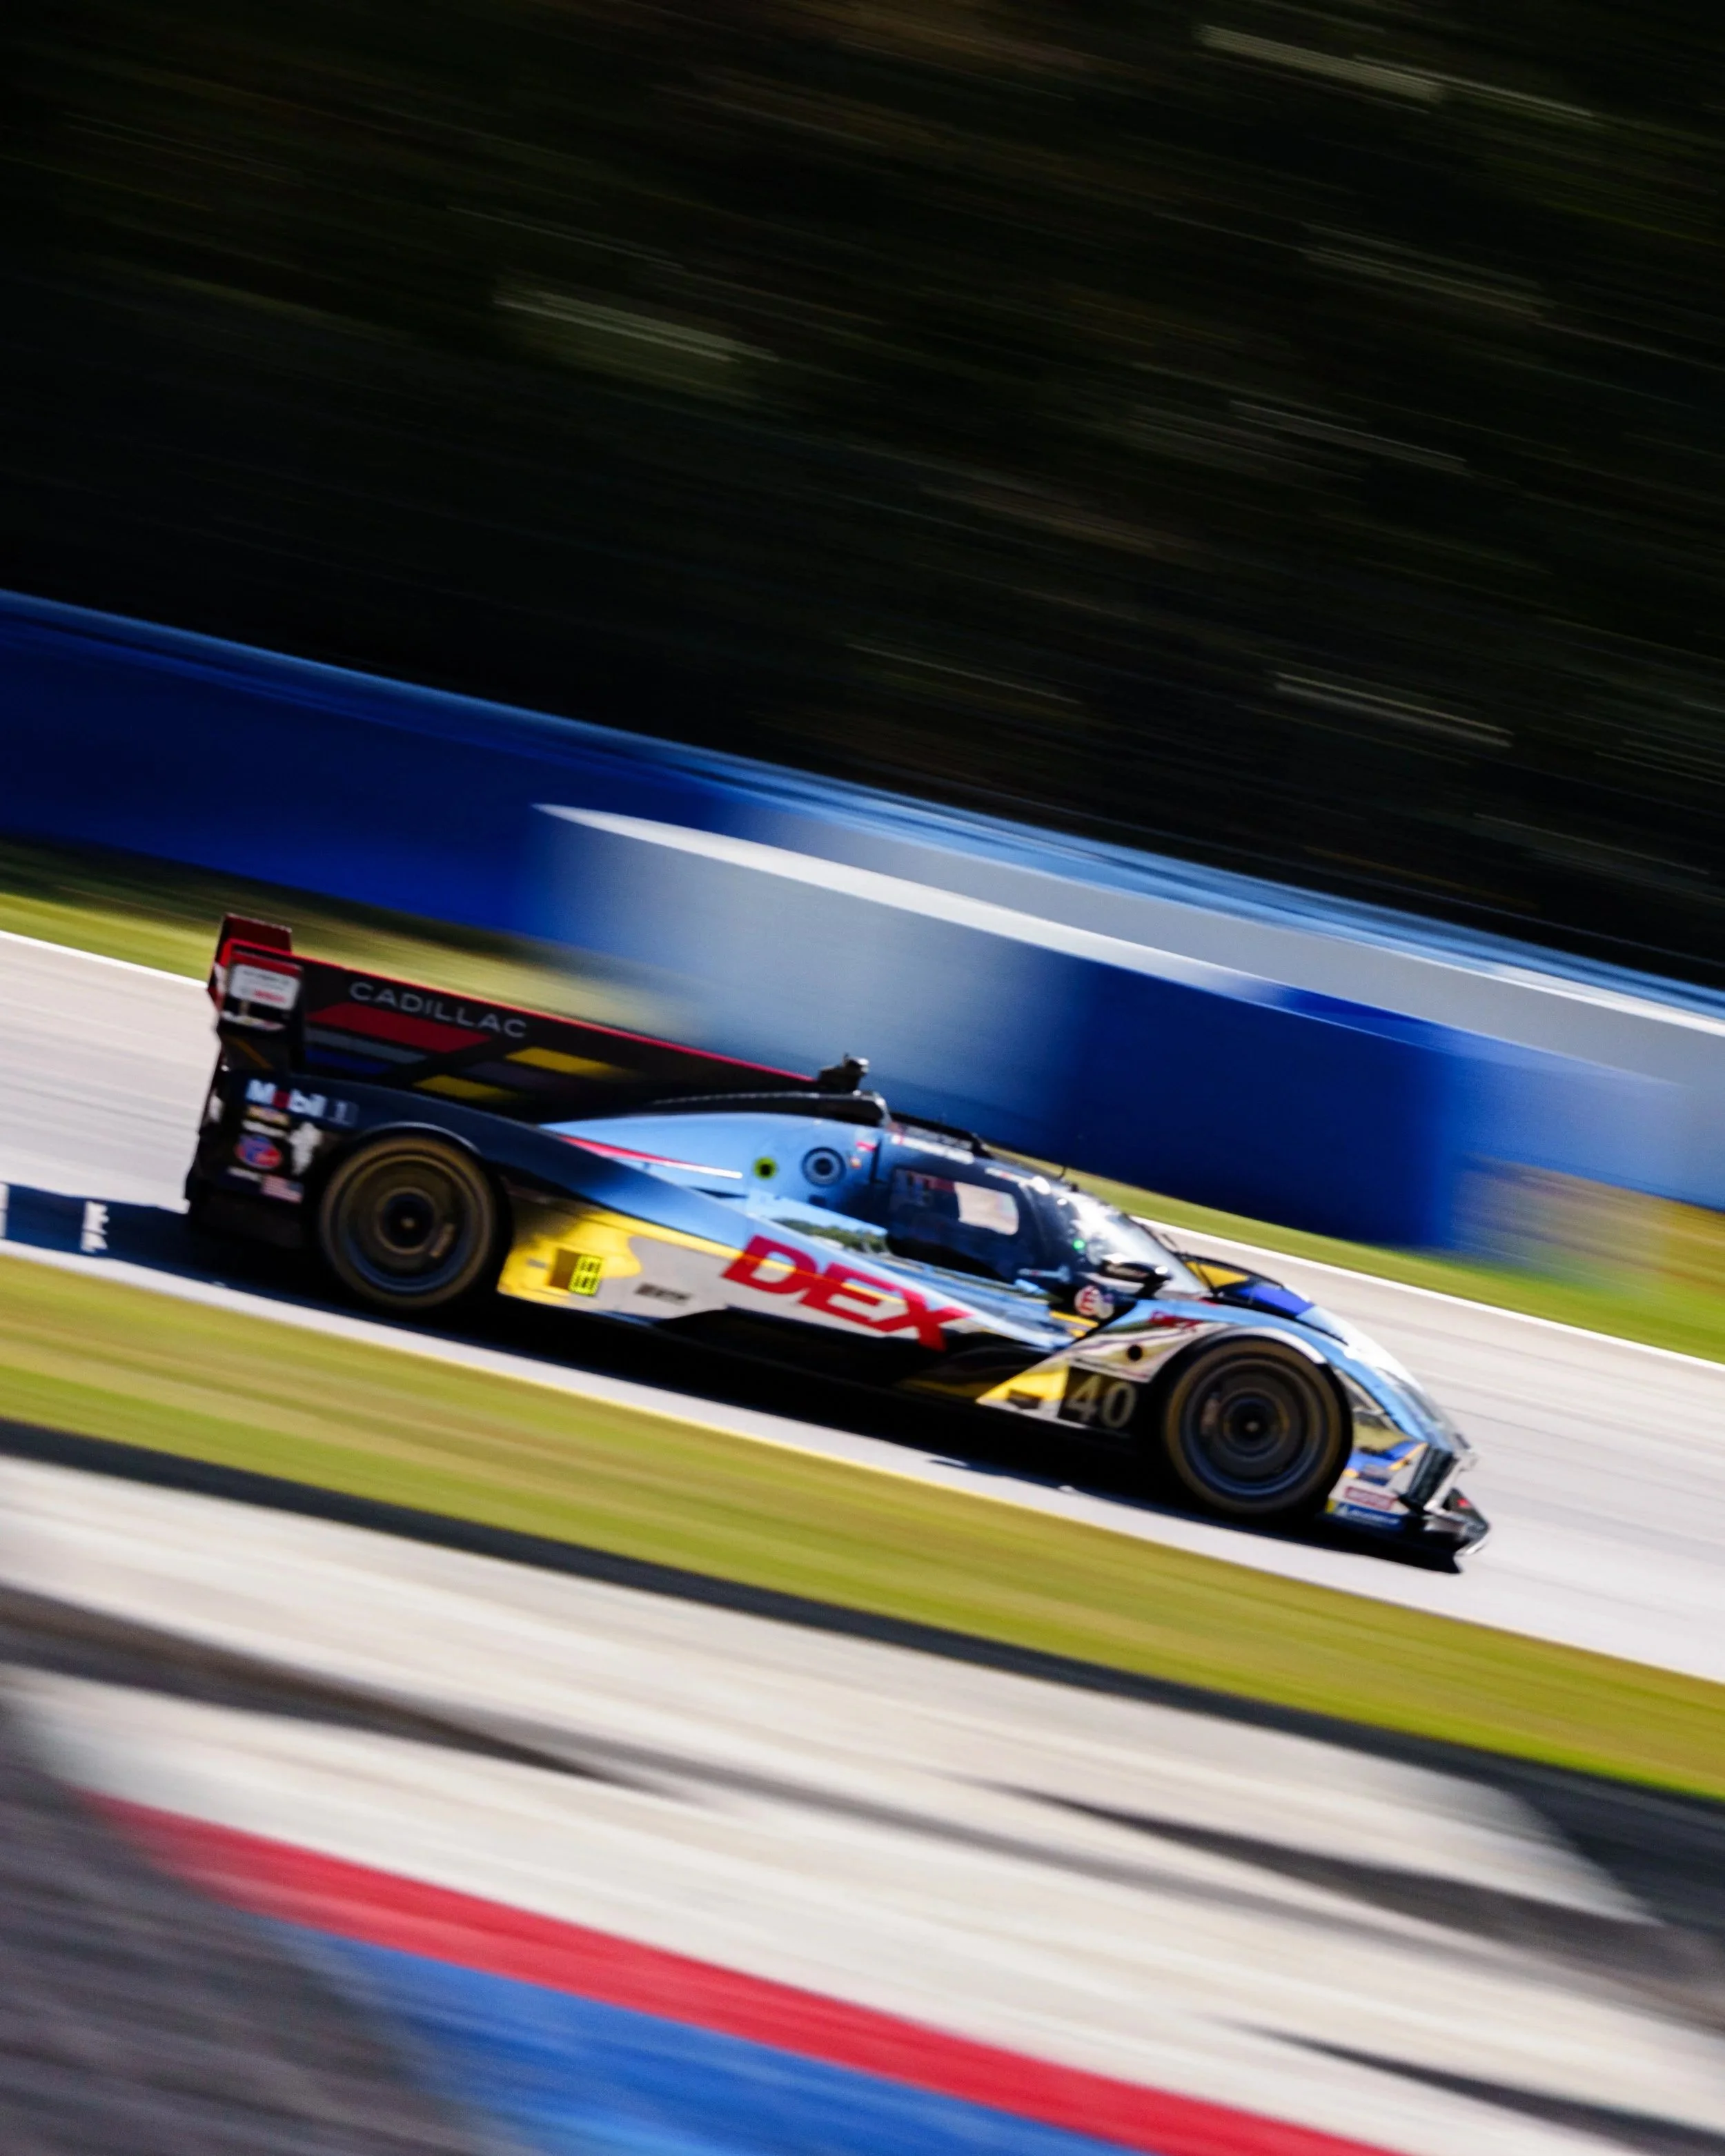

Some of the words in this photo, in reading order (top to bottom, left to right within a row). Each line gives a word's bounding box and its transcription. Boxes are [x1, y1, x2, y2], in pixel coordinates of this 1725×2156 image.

[349, 981, 526, 1038] CADILLAC
[720, 1234, 976, 1352] DEX
[1063, 1373, 1136, 1429] 40
